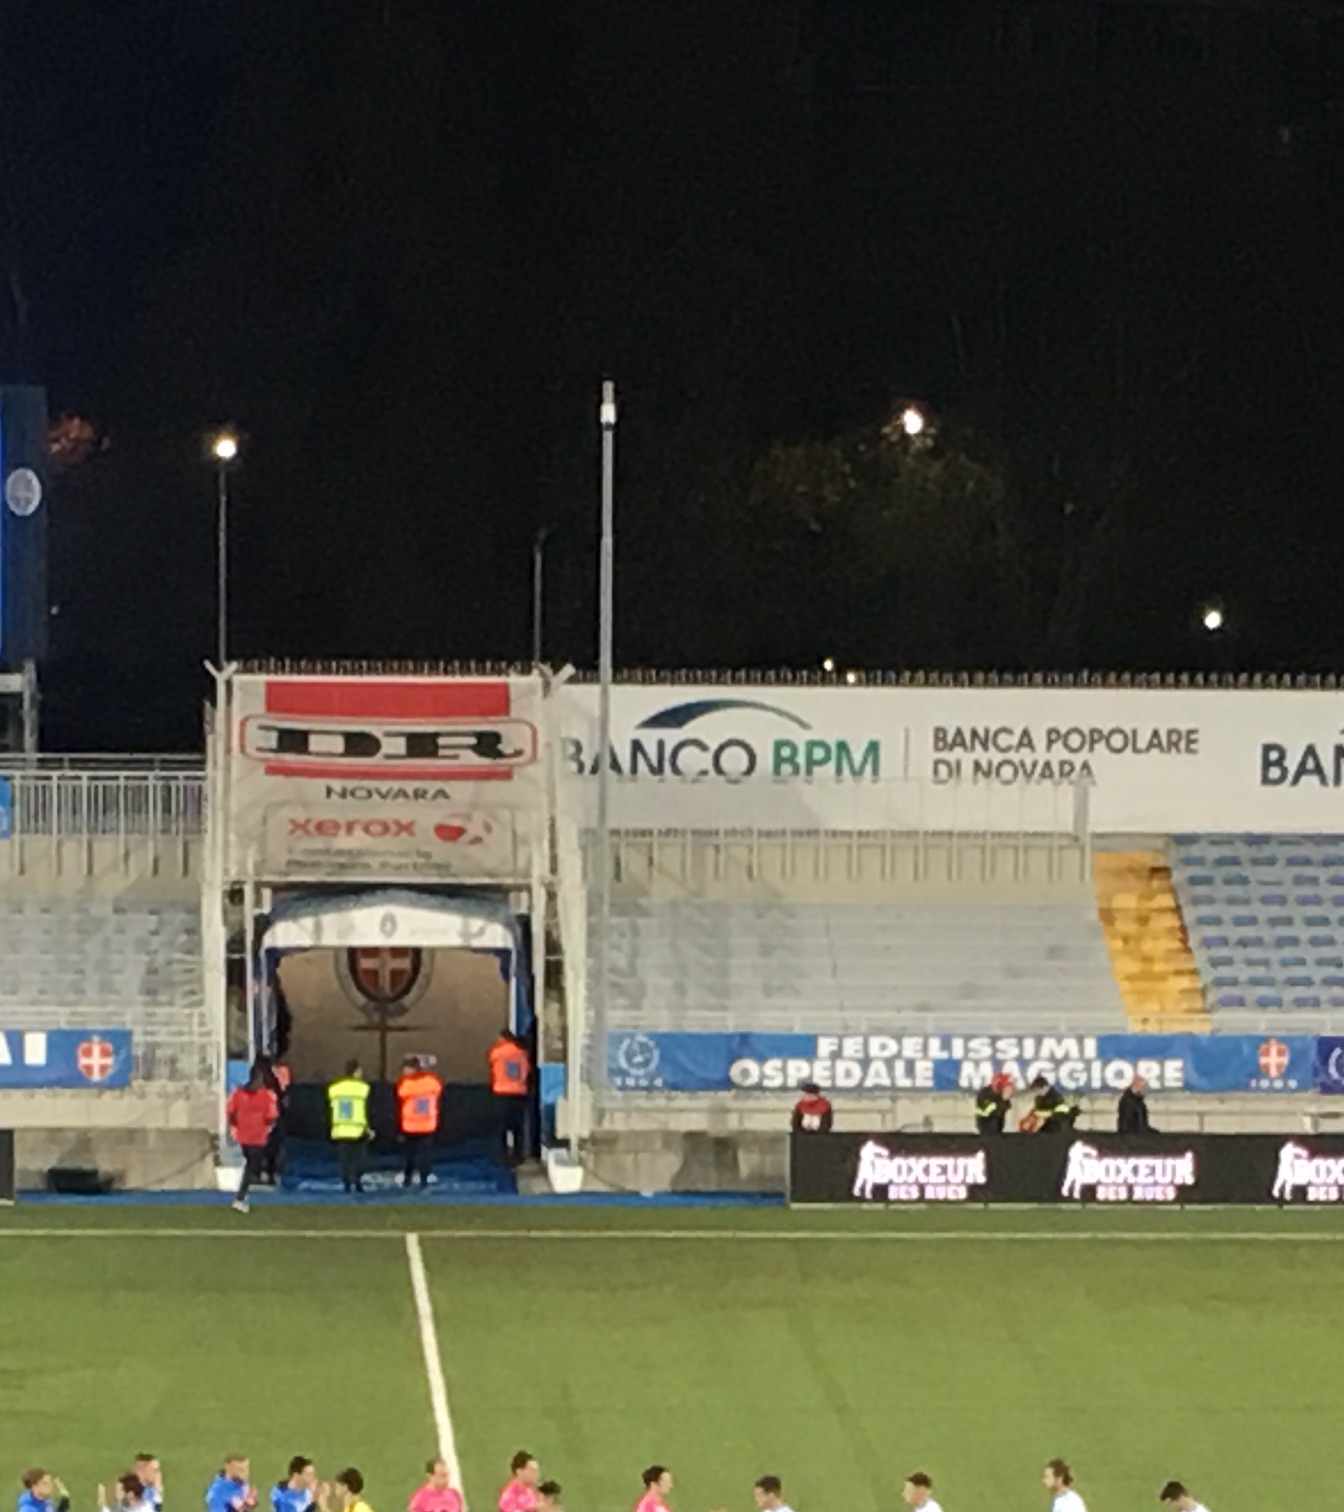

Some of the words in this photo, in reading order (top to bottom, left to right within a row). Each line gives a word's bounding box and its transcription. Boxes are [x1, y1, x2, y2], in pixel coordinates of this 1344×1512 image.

[256, 723, 524, 760] DR
[932, 726, 1037, 754] BANCA
[1045, 727, 1200, 755] POPOLARE
[560, 737, 758, 784] BANCO
[772, 738, 881, 784] BPM
[932, 757, 962, 786] DI
[972, 758, 1097, 786] NOVARA
[324, 784, 452, 801] NOVARA
[287, 815, 417, 838] xerox
[816, 1036, 1097, 1060] FEDELISSIMI
[728, 1060, 934, 1088] OSPEDALE
[959, 1060, 1185, 1090] MAGGIORE
[876, 1152, 987, 1184] BOXEUR
[1084, 1153, 1195, 1185] BOXEUR
